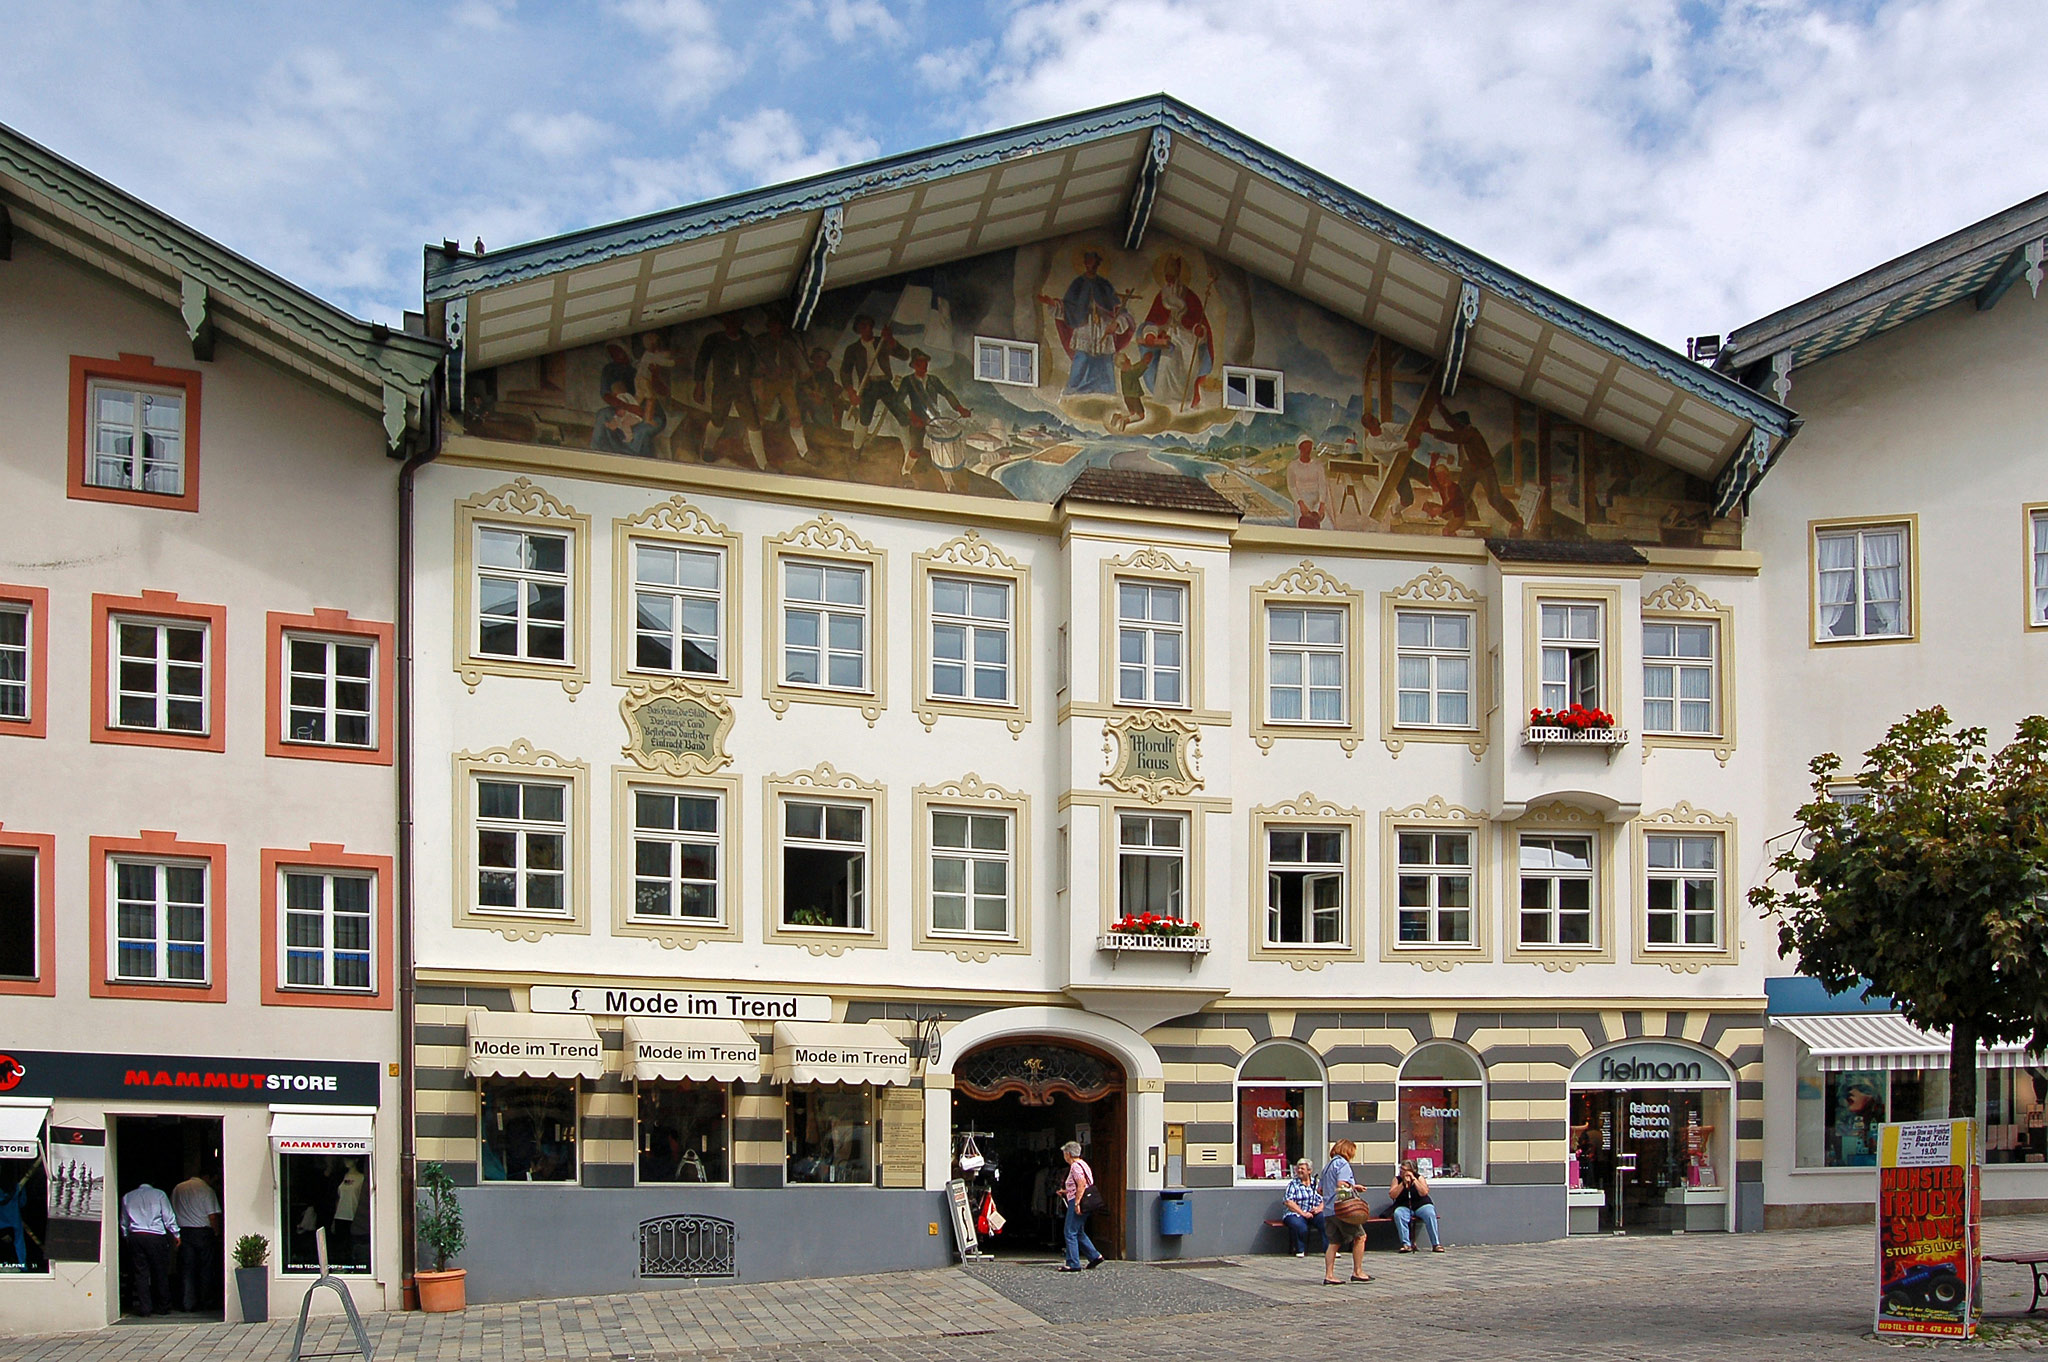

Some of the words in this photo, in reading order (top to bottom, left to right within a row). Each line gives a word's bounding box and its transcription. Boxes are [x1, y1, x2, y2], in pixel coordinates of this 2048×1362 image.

[688, 707, 708, 719] Stadt
[687, 718, 705, 729] Land
[677, 724, 698, 739] durch
[698, 731, 711, 741] der
[684, 739, 706, 751] Band
[605, 990, 679, 1014] Mode
[687, 993, 718, 1015] im
[725, 995, 798, 1018] Trend
[474, 1041, 521, 1055] Mode
[525, 1042, 545, 1056] im
[549, 1042, 599, 1057] Trend
[639, 1045, 683, 1059] Mode
[687, 1046, 706, 1060] im
[709, 1047, 757, 1061] Trend
[795, 1049, 837, 1063] Mode
[842, 1050, 859, 1064] im
[863, 1051, 907, 1065] Trend
[1902, 1142, 1912, 1150] 27
[1882, 1166, 1964, 1191] MONSTER
[1882, 1188, 1964, 1217] TRUCK
[1892, 1217, 1955, 1243] SHOW
[1886, 1242, 1933, 1258] STUNTS
[1935, 1239, 1963, 1252] LIVE
